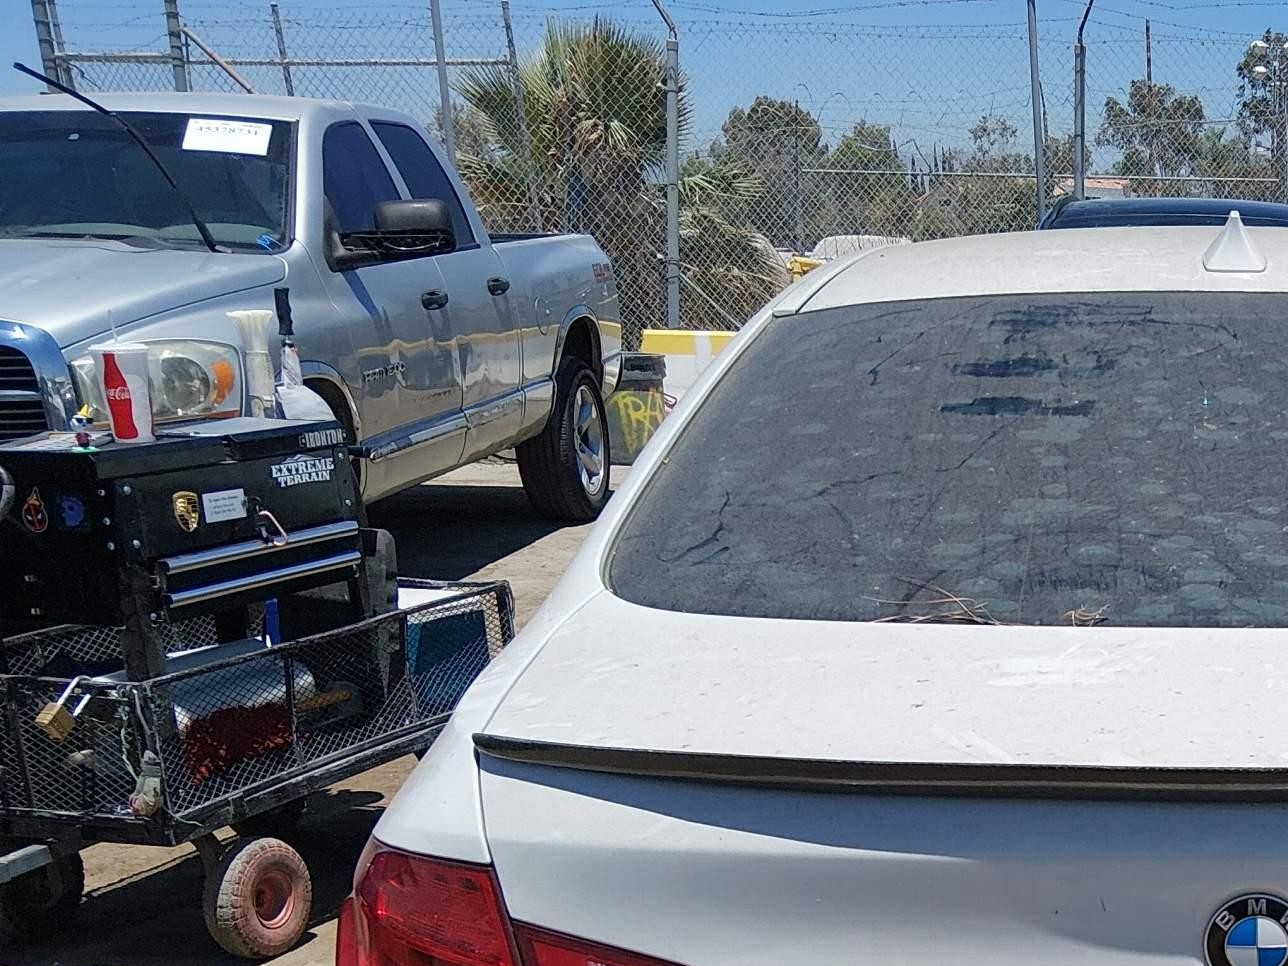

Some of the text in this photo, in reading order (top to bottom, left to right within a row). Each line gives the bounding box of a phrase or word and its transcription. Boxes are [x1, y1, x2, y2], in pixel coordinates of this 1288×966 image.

[303, 428, 344, 448] IRONTON
[270, 457, 335, 478] EXTREME
[278, 470, 331, 488] TERRAIN
